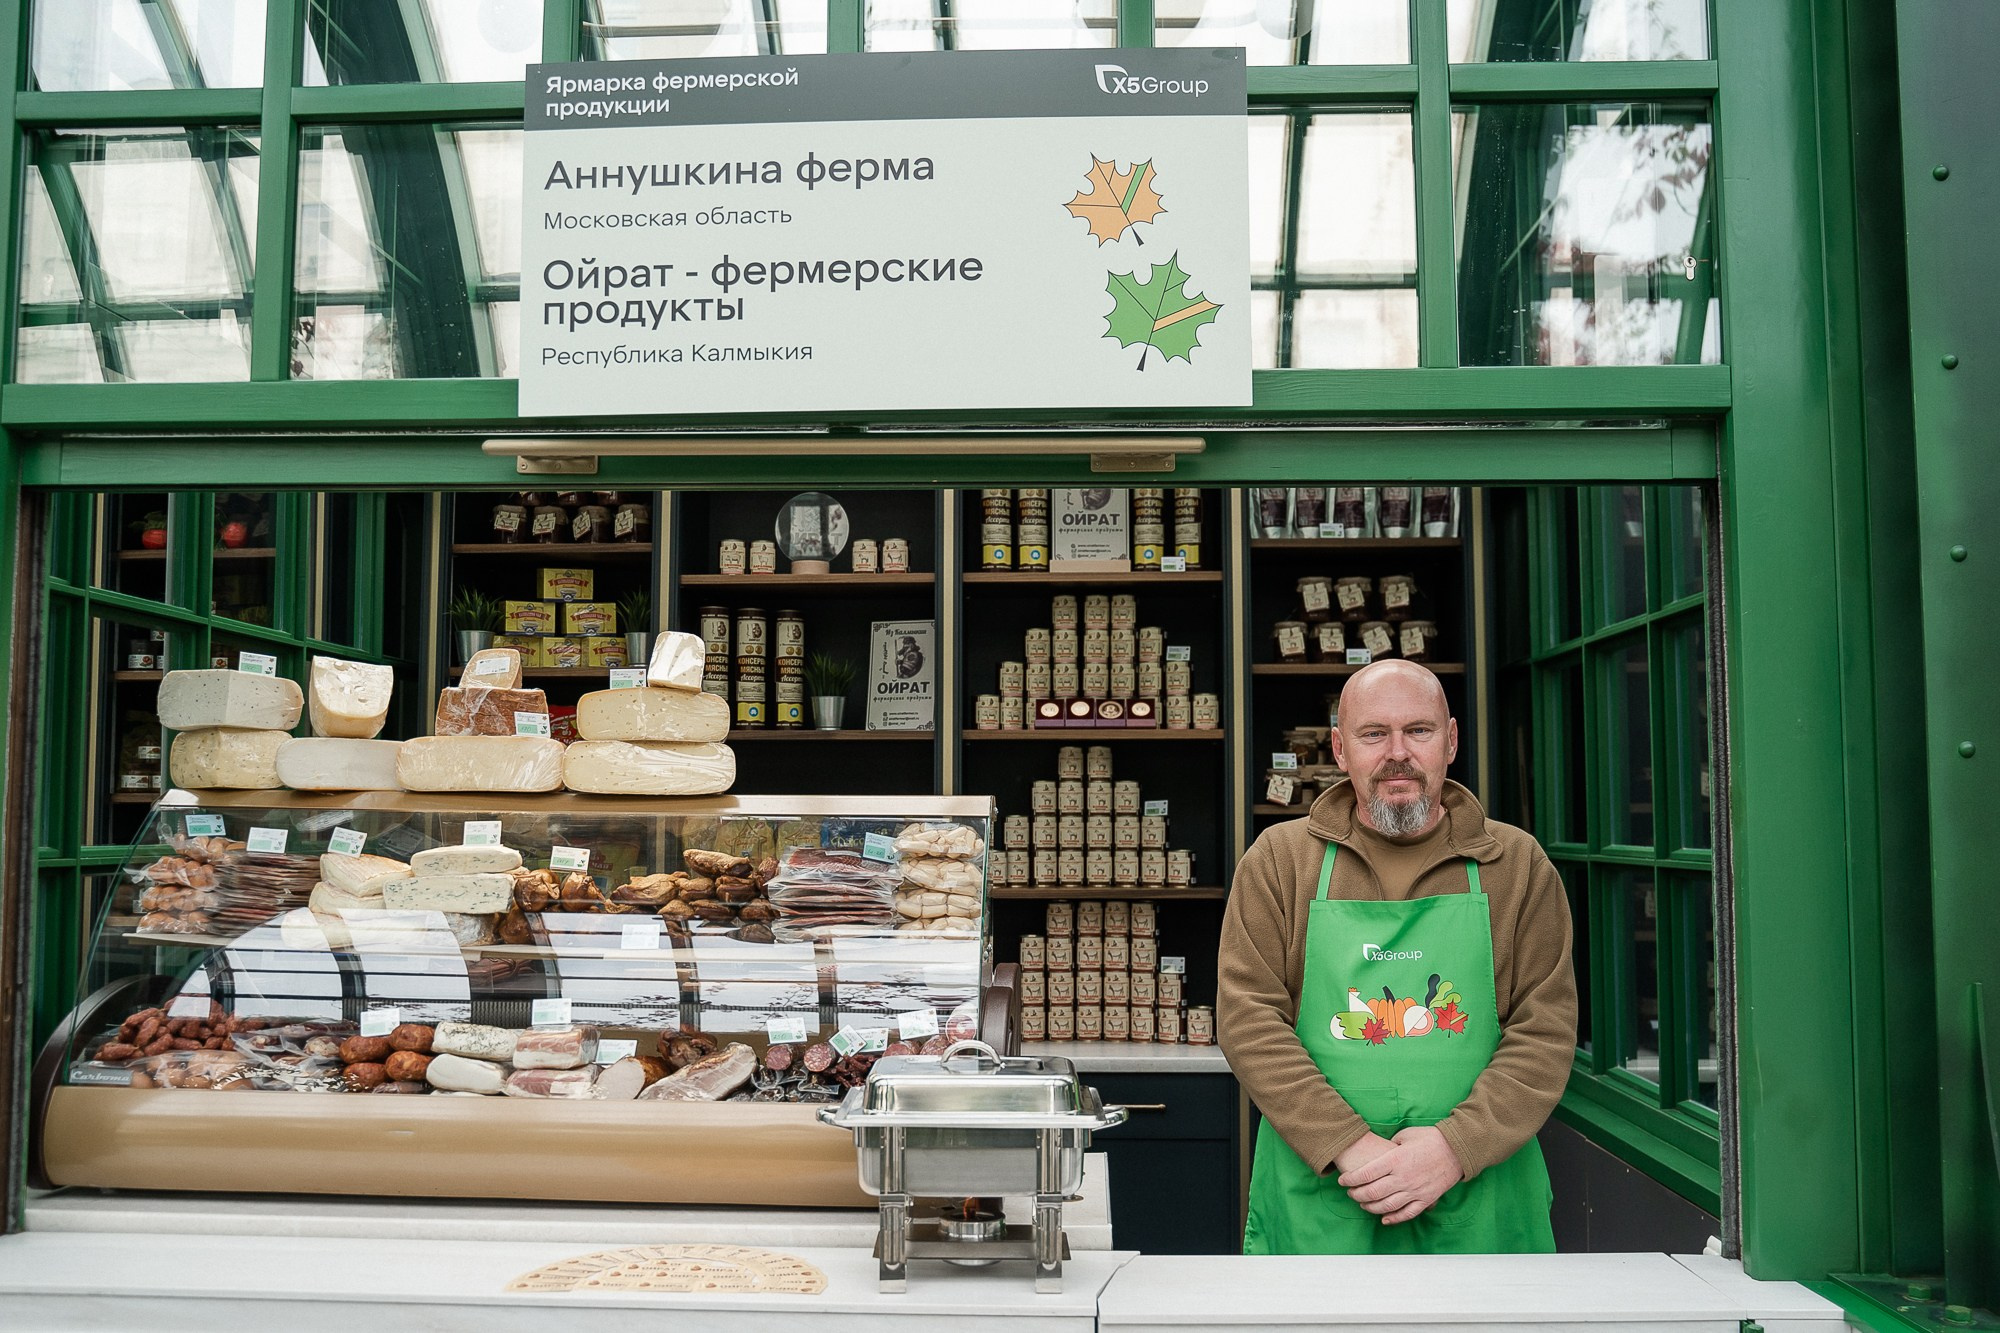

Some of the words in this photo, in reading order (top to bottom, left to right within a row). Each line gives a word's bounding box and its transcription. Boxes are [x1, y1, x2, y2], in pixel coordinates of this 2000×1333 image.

[546, 75, 646, 96] Ярмарка
[652, 67, 799, 95] фермерской
[545, 98, 671, 120] продукции
[543, 160, 783, 195] Аннушкина
[796, 151, 935, 191] ферма
[543, 210, 688, 230] Московская
[695, 206, 793, 225] область
[542, 256, 673, 296] Ойрат
[711, 250, 984, 291] фермерские
[543, 291, 745, 333] продукты
[542, 343, 684, 368] Республика
[692, 342, 813, 363] Калмыкия
[1062, 510, 1121, 526] ОЙРАТ
[877, 679, 931, 694] ОЙРАТ
[71, 1070, 131, 1081] Carboma
